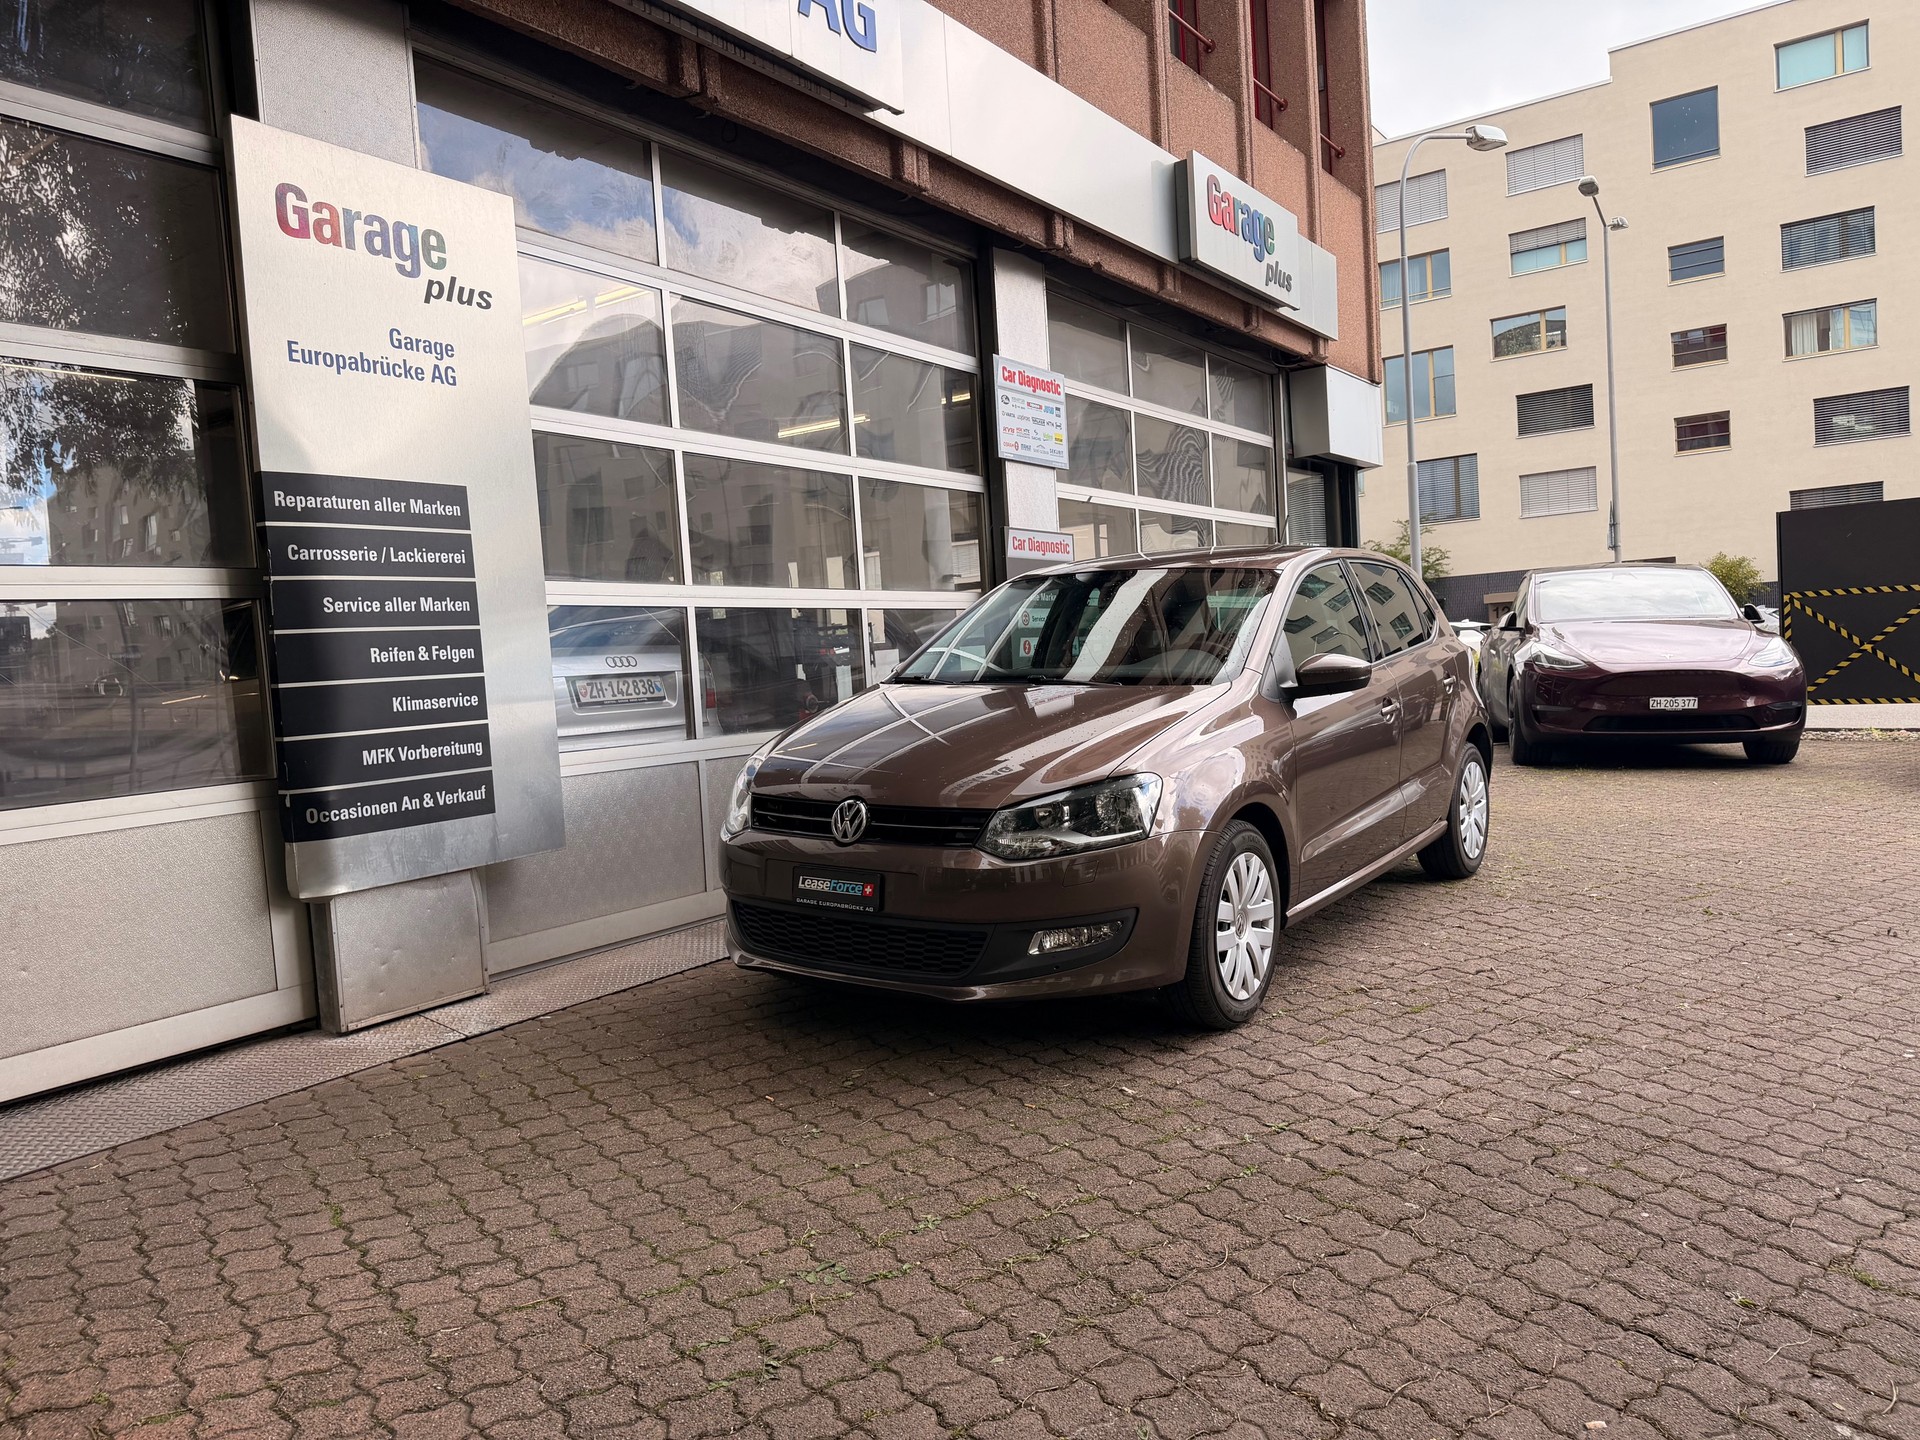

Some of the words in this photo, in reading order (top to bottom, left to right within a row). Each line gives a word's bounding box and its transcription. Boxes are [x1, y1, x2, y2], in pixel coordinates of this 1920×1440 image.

[275, 182, 447, 279] Garage
[1207, 174, 1275, 262] Garage
[1265, 261, 1293, 293] plus
[424, 276, 493, 311] plus
[389, 328, 455, 359] Garage
[287, 340, 425, 382] Europabrücke
[431, 364, 457, 387] AG
[1002, 366, 1016, 383] Car
[1018, 370, 1061, 396] Diagnostic
[273, 490, 370, 512] Reparaturen
[374, 497, 406, 514] aller
[410, 499, 461, 517] Marken
[287, 544, 378, 563] Carrosserie
[390, 547, 466, 565] Lackiererei
[1012, 536, 1026, 551] Car
[1028, 537, 1070, 556] Diagnostic
[323, 597, 380, 614] Service
[384, 597, 416, 613] aller
[420, 597, 470, 613] Marken
[370, 646, 415, 664] Reifen
[418, 646, 430, 661] &
[432, 645, 475, 664] Felgen
[392, 693, 479, 713] Klimaservice
[1681, 698, 1697, 707] 377
[362, 748, 395, 767] MFK
[398, 741, 483, 763] Vorbereitung
[305, 800, 397, 825] Occasionen
[401, 796, 421, 812] An
[423, 793, 435, 809] &
[436, 785, 487, 807] Verkauf
[797, 875, 864, 896] LeaseForce
[796, 897, 818, 906] GARAGE
[818, 900, 864, 911] EUROPABRÜCKE
